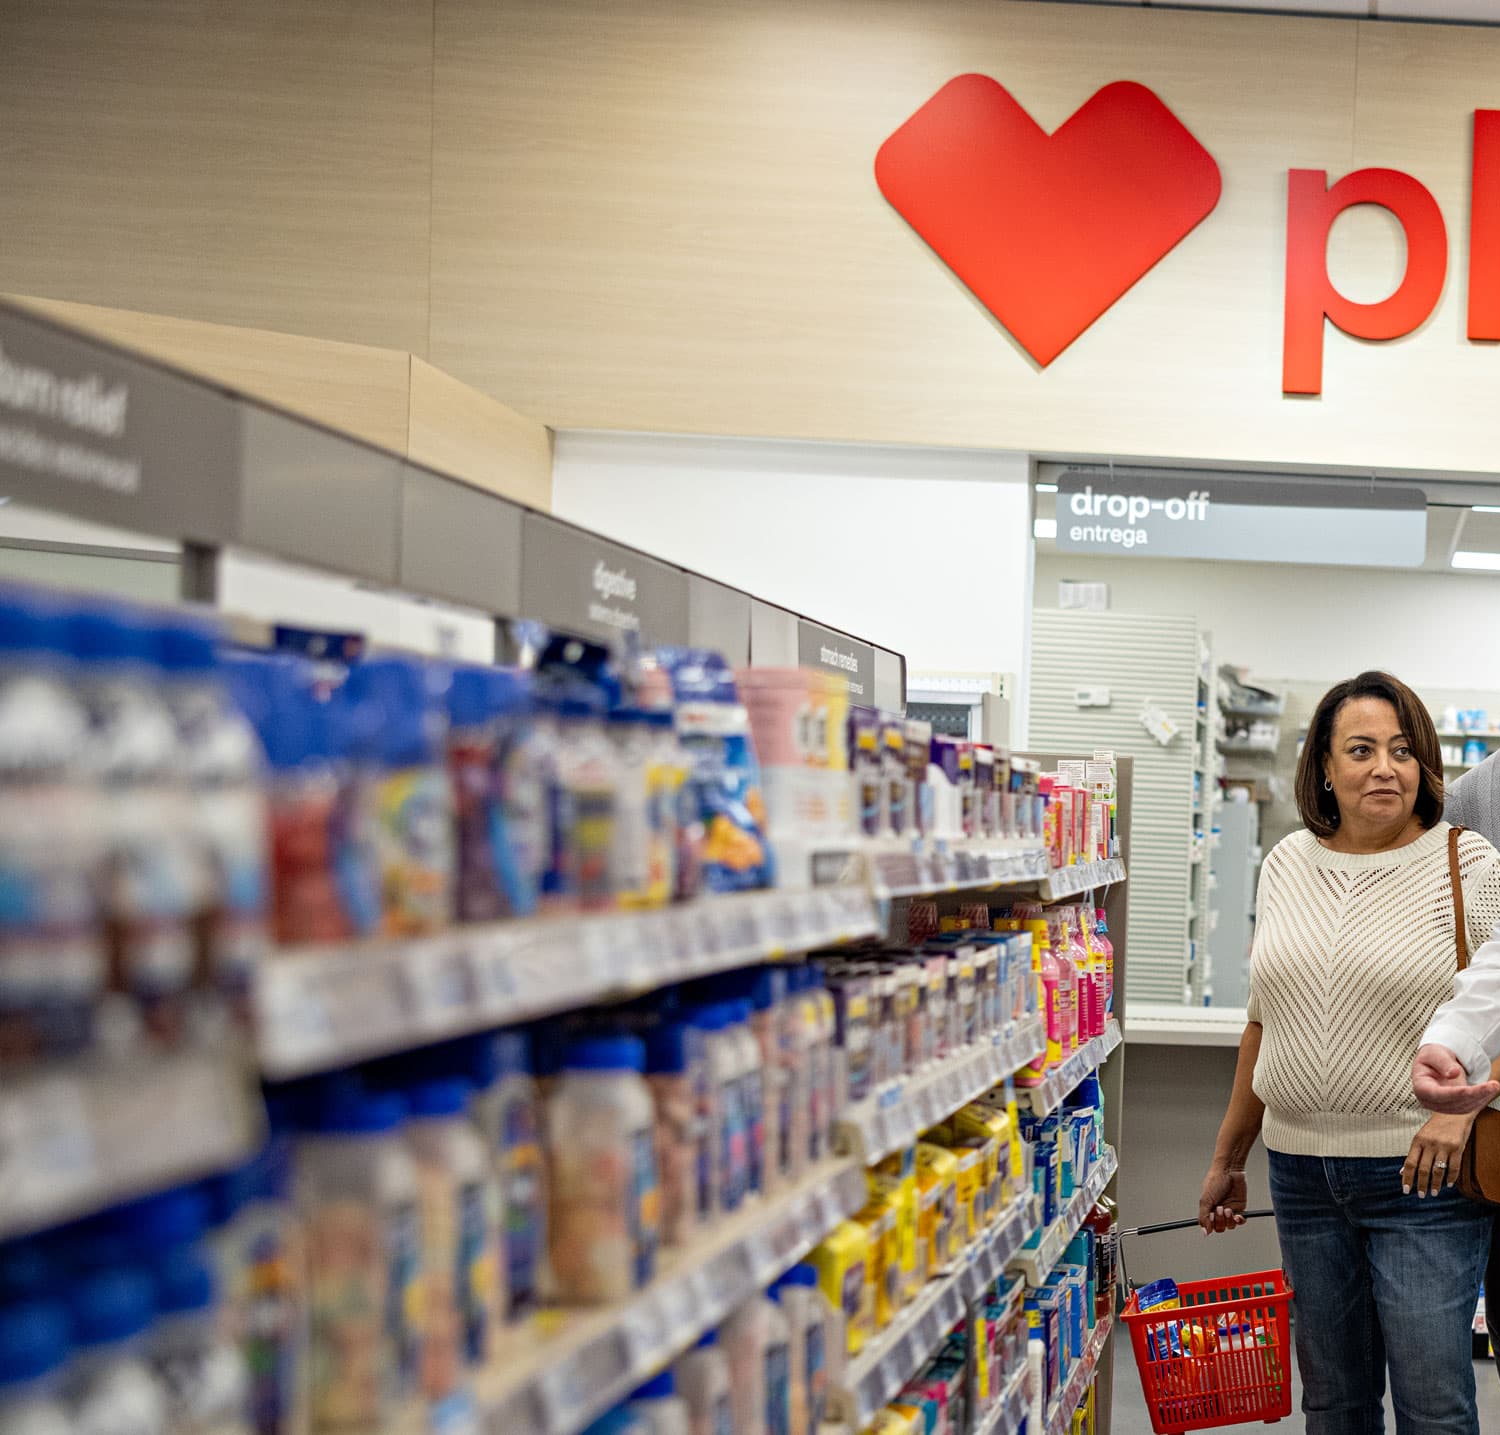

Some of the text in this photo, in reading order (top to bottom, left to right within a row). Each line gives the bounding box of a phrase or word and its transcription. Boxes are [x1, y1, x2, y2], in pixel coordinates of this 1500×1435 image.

[1070, 486, 1210, 525] drop-off
[1070, 524, 1148, 548] entrega
[820, 645, 858, 673] stomach remedies
